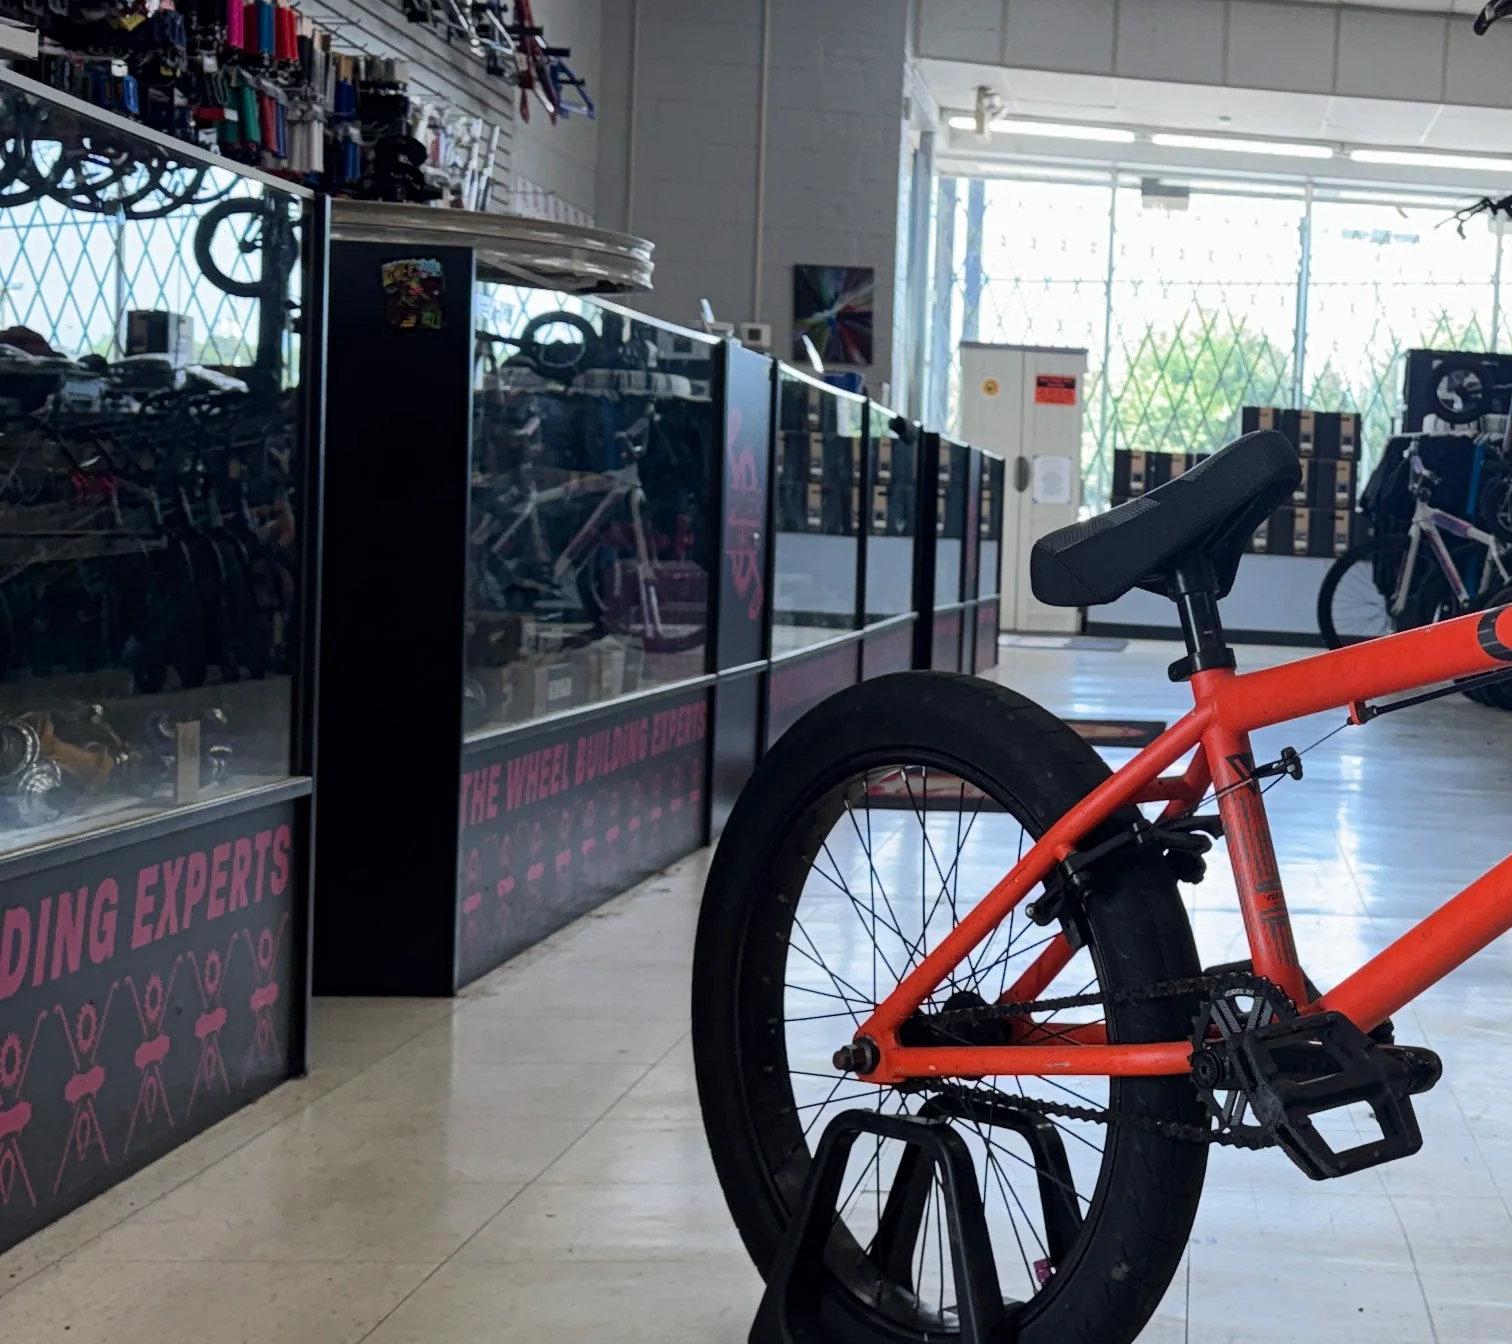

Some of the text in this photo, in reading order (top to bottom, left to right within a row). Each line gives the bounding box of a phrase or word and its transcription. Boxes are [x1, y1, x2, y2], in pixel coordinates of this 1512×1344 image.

[459, 700, 708, 830] THE WHEEL BUILDING EXPERTS
[131, 824, 291, 950] EXPERTS
